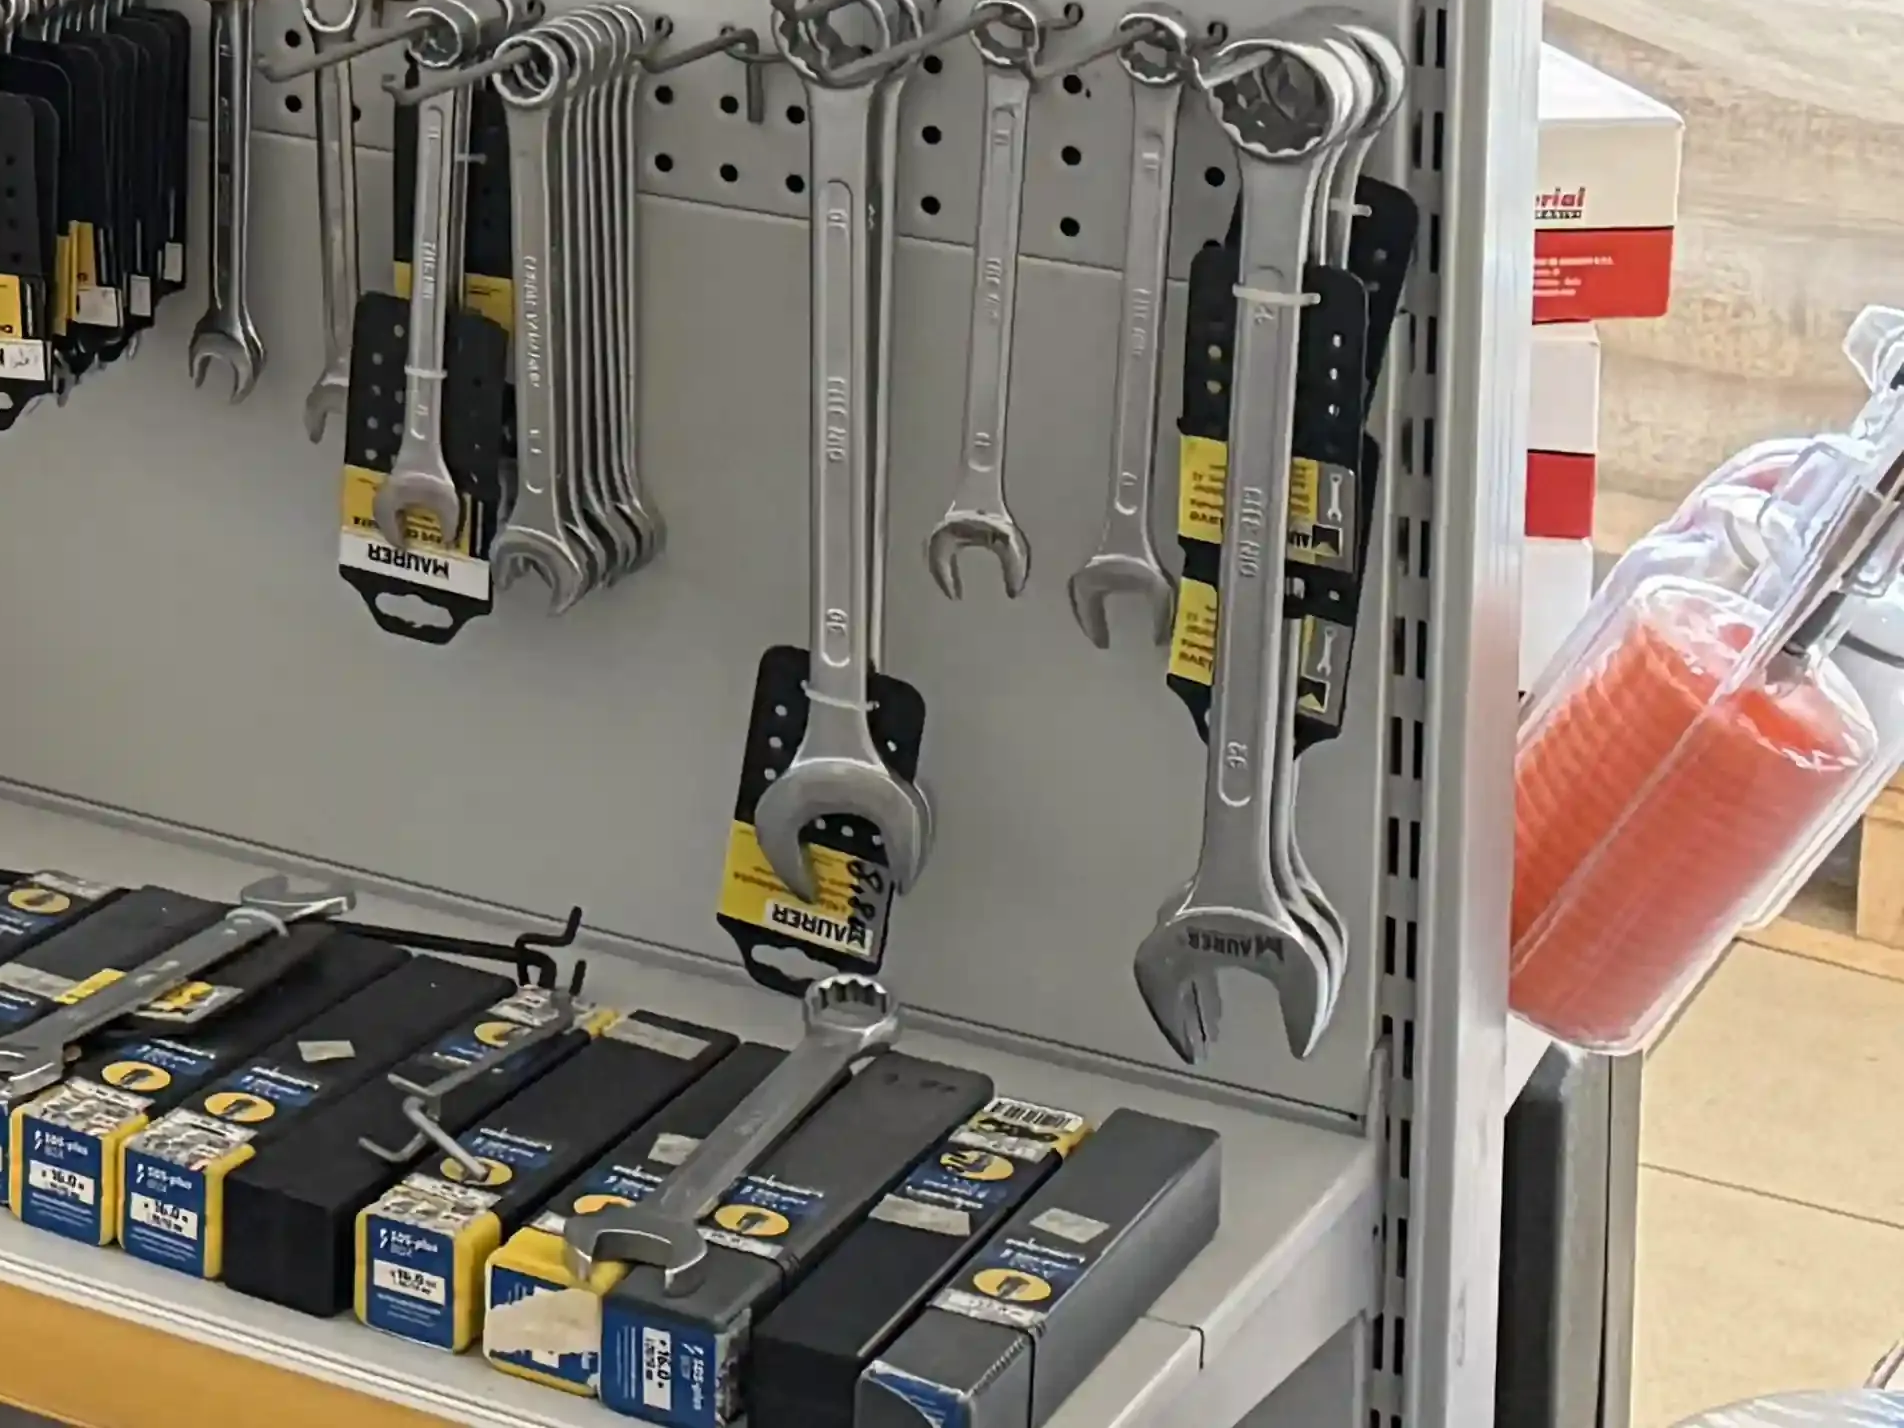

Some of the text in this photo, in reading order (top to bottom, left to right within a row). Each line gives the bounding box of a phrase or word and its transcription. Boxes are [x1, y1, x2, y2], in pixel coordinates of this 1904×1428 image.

[1535, 186, 1586, 208] rial
[367, 542, 450, 581] MAURER
[771, 902, 868, 950] MAURER
[1188, 928, 1285, 962] MAURER
